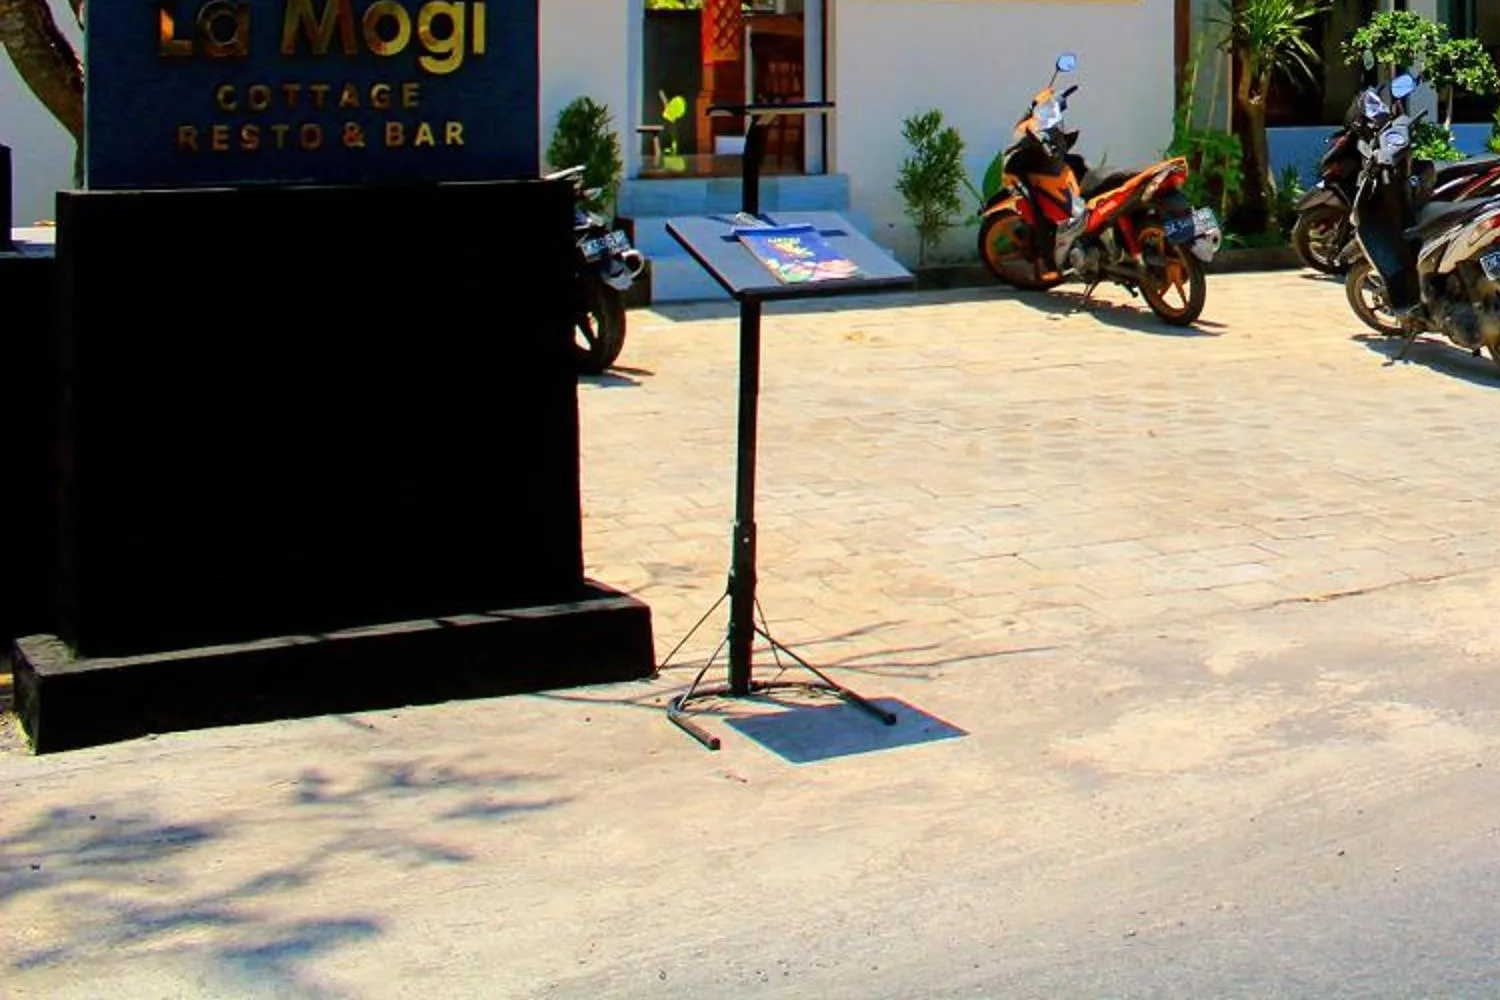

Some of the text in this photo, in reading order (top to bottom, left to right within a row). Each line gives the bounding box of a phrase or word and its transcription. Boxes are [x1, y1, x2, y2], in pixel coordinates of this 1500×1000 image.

[216, 82, 421, 112] COTTAGE
[178, 121, 465, 151] RESTO & BAR
